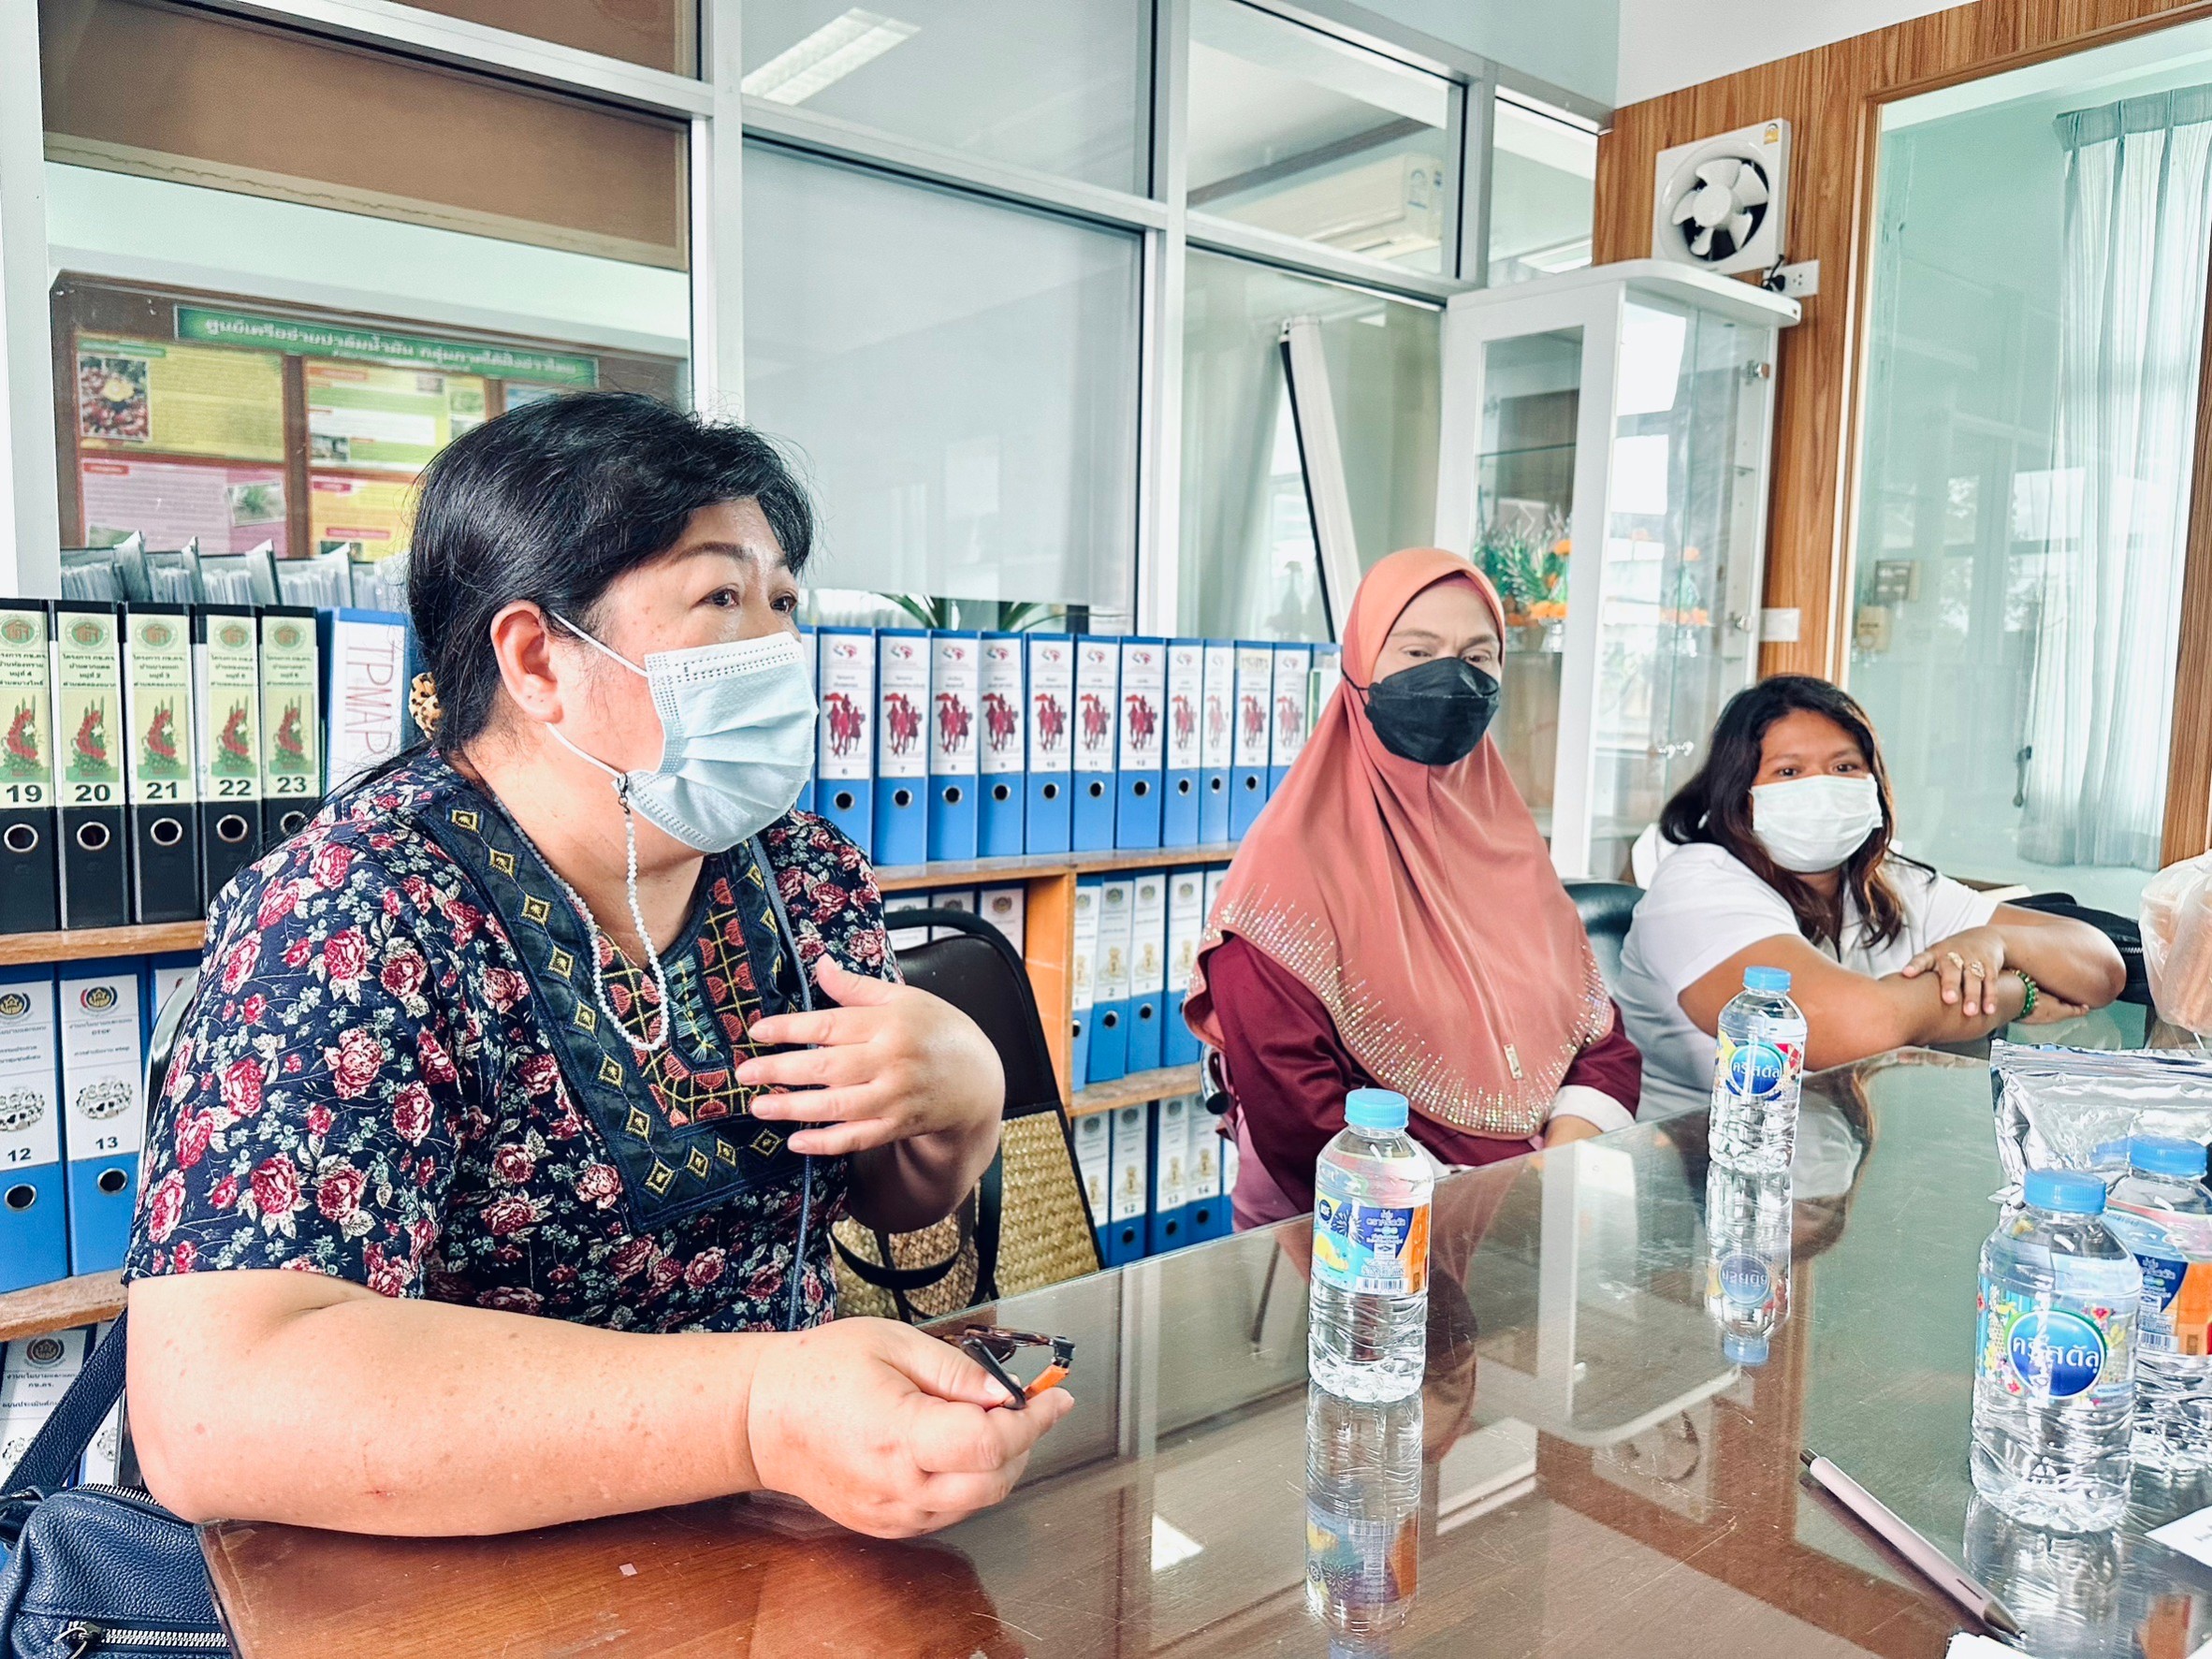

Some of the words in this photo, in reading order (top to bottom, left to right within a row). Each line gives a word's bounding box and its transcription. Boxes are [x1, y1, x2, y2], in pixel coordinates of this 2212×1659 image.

[345, 640, 394, 754] TPMAP
[7, 785, 42, 803] 19
[75, 784, 111, 802] 20
[146, 781, 179, 800] 21
[218, 779, 252, 797] 22
[277, 777, 308, 793] 23
[95, 1136, 119, 1150] 13
[7, 1147, 32, 1162] 12
[2013, 1335, 2100, 1375] คริสตัล
